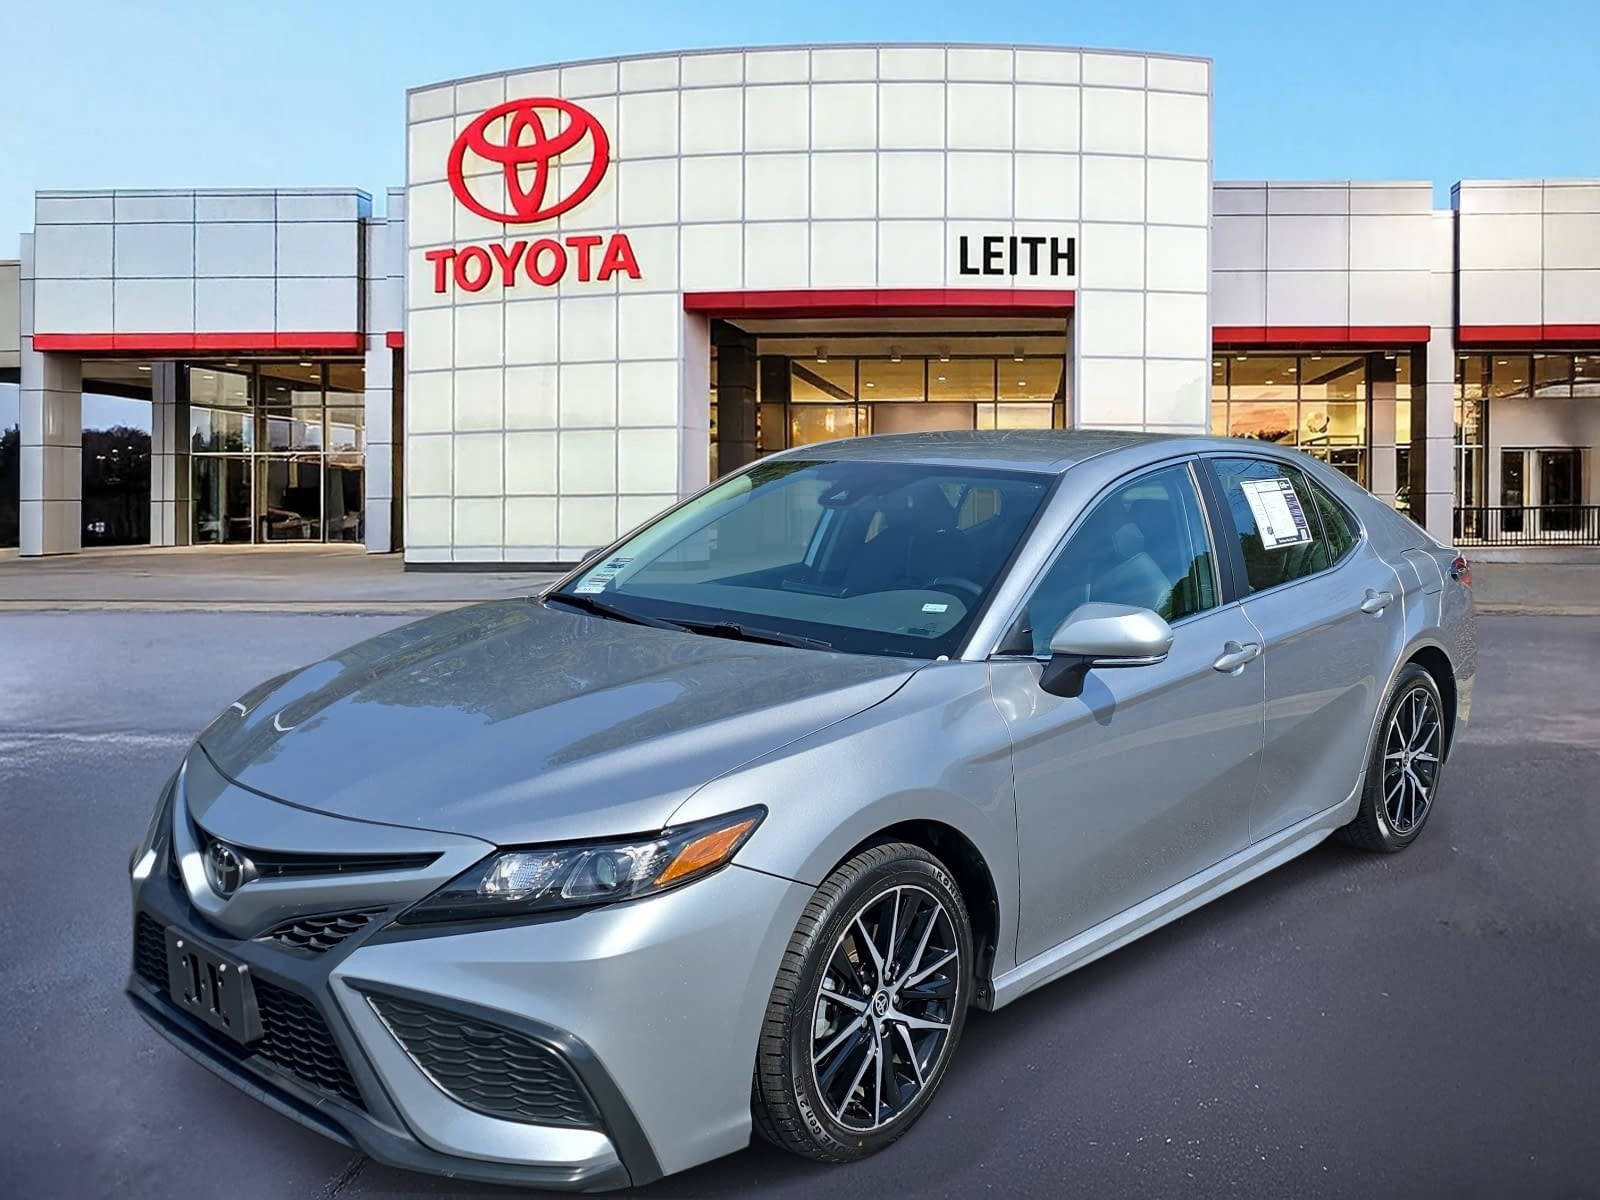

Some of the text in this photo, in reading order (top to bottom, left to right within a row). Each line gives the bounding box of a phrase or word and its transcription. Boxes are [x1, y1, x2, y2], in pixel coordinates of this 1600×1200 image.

[425, 233, 641, 293] TOYOTA
[960, 236, 1075, 276] LEITH
[806, 1110, 822, 1135] Gen
